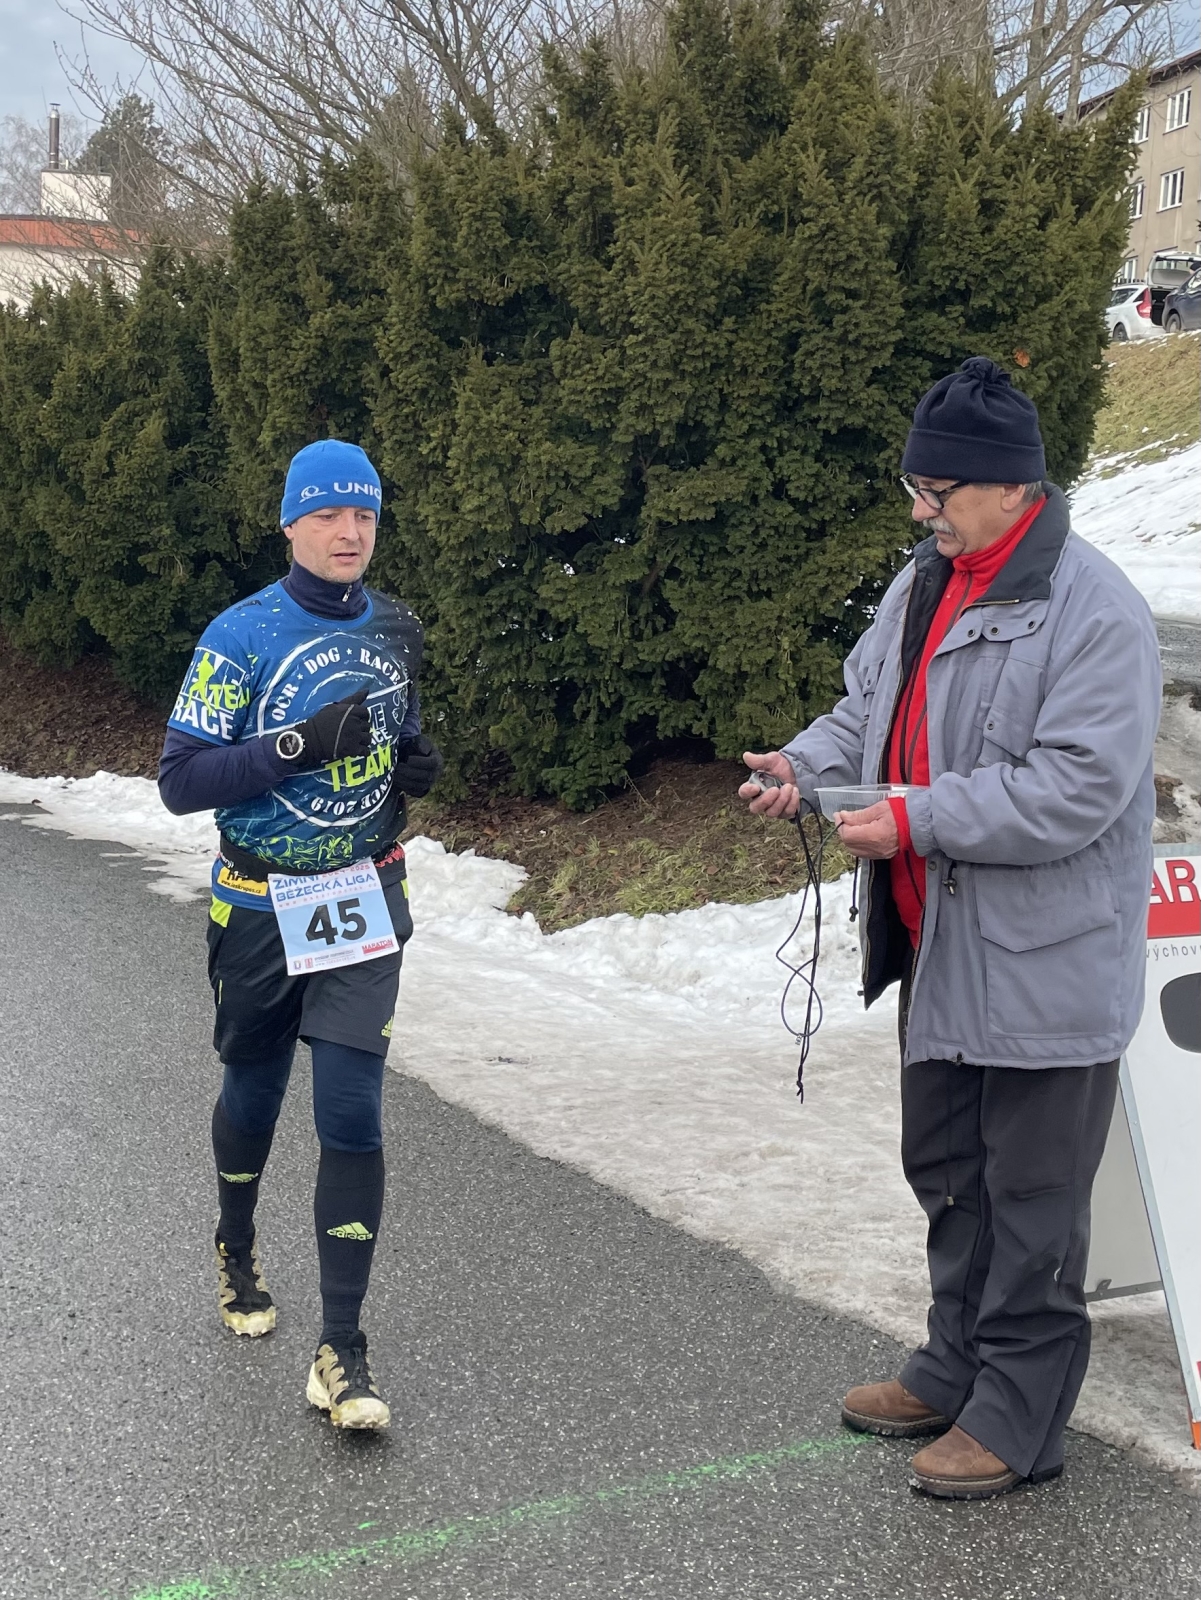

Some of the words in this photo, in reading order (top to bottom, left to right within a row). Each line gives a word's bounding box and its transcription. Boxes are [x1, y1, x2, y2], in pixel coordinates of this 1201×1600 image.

[271, 682, 299, 722] OCR
[303, 646, 340, 675] DOG
[169, 694, 234, 740] RACE
[325, 740, 392, 793] TEAM
[310, 796, 358, 816] 2019
[345, 873, 375, 886] LIGA
[305, 897, 368, 946] 45
